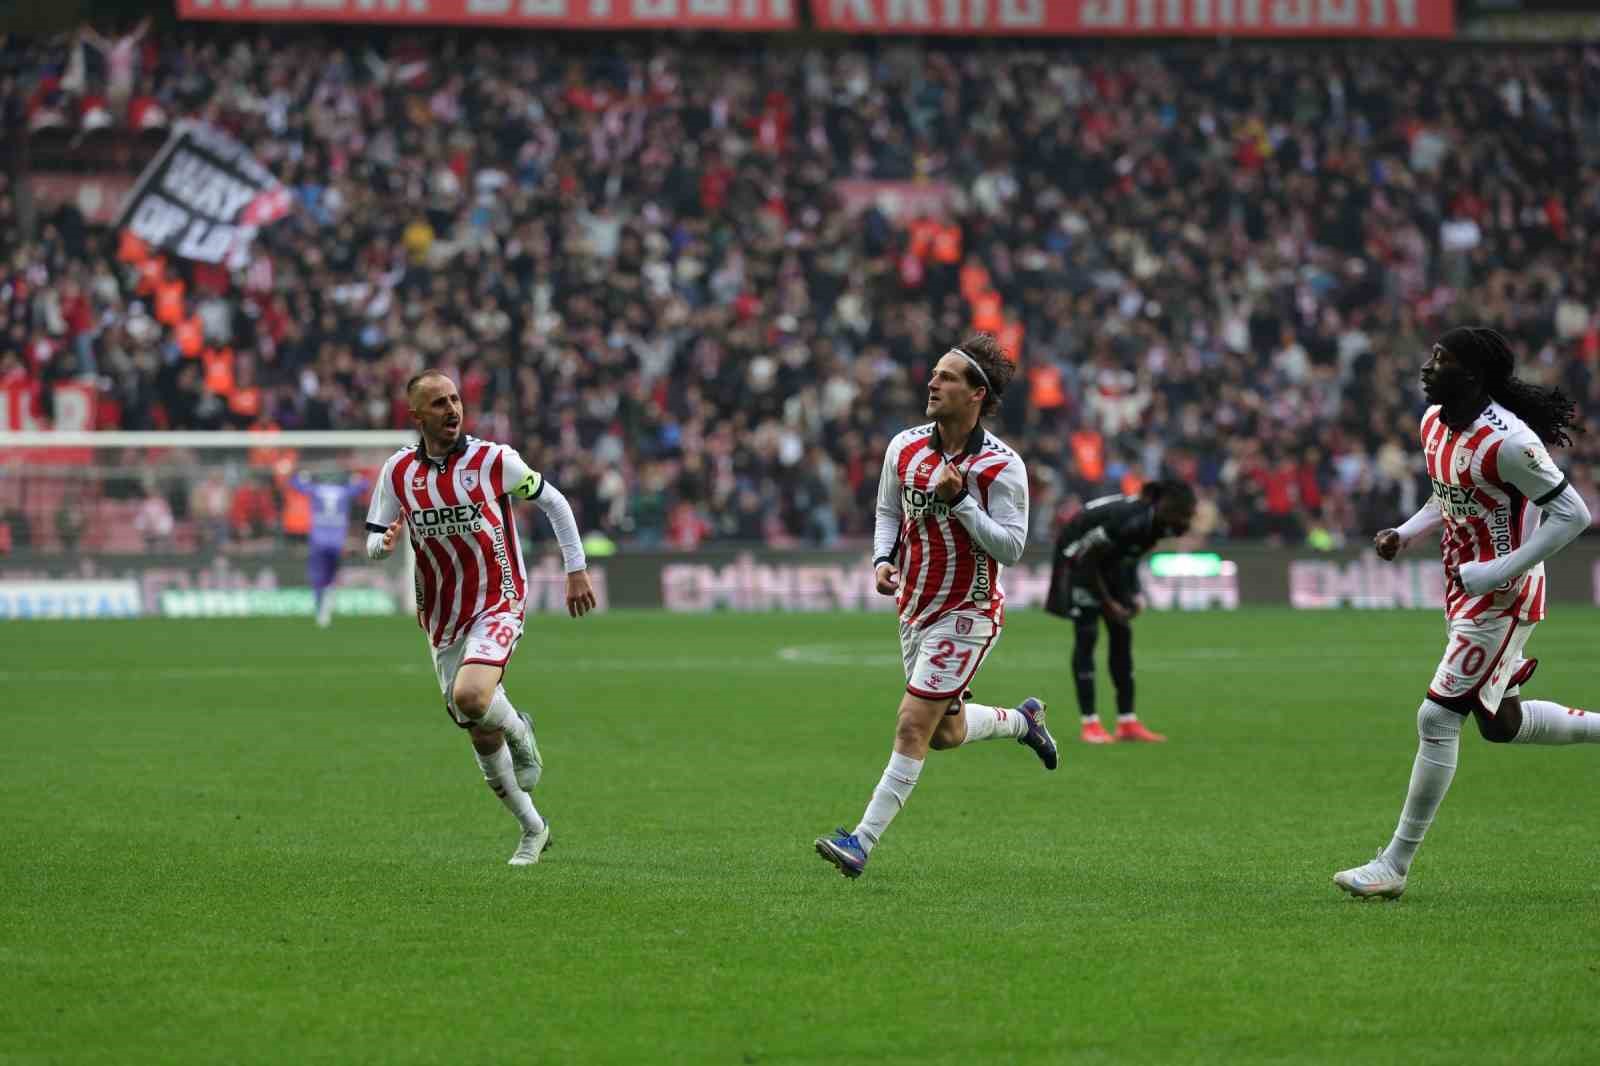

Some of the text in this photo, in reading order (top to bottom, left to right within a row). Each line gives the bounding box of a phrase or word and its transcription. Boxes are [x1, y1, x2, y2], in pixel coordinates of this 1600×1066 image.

[411, 504, 482, 526] COREX
[416, 521, 481, 537] HOLDING
[485, 621, 514, 648] 18
[930, 640, 973, 678] 21
[1448, 634, 1486, 676] 70
